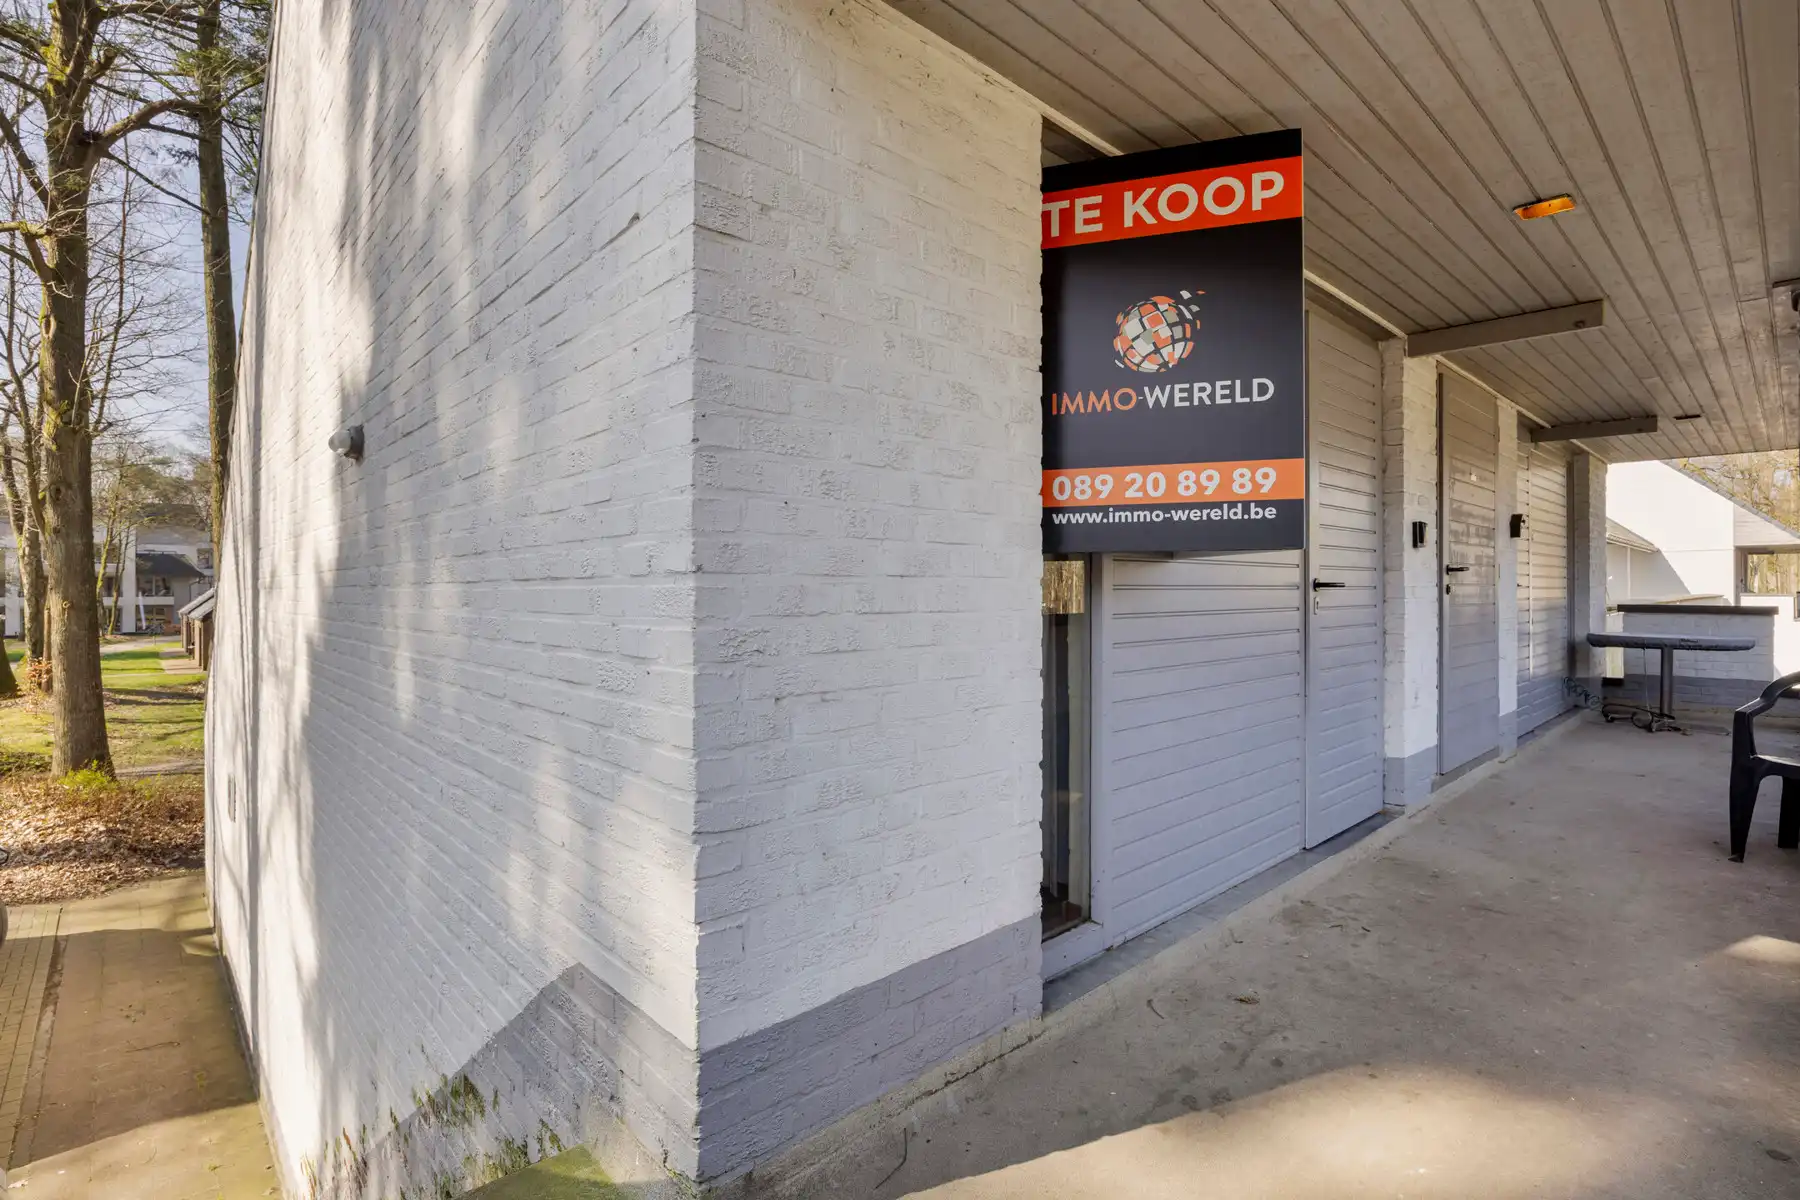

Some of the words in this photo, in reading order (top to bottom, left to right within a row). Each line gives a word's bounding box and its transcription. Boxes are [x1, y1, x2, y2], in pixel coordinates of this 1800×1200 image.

[1042, 195, 1103, 237] TE
[1124, 171, 1284, 228] KOOP
[1051, 377, 1275, 415] IMMO-WERELD
[1052, 474, 1114, 500] 089
[1124, 472, 1166, 498] 20
[1177, 469, 1220, 496] 89
[1232, 467, 1277, 494] 89
[1052, 503, 1277, 524] www.immo-wereld.be
